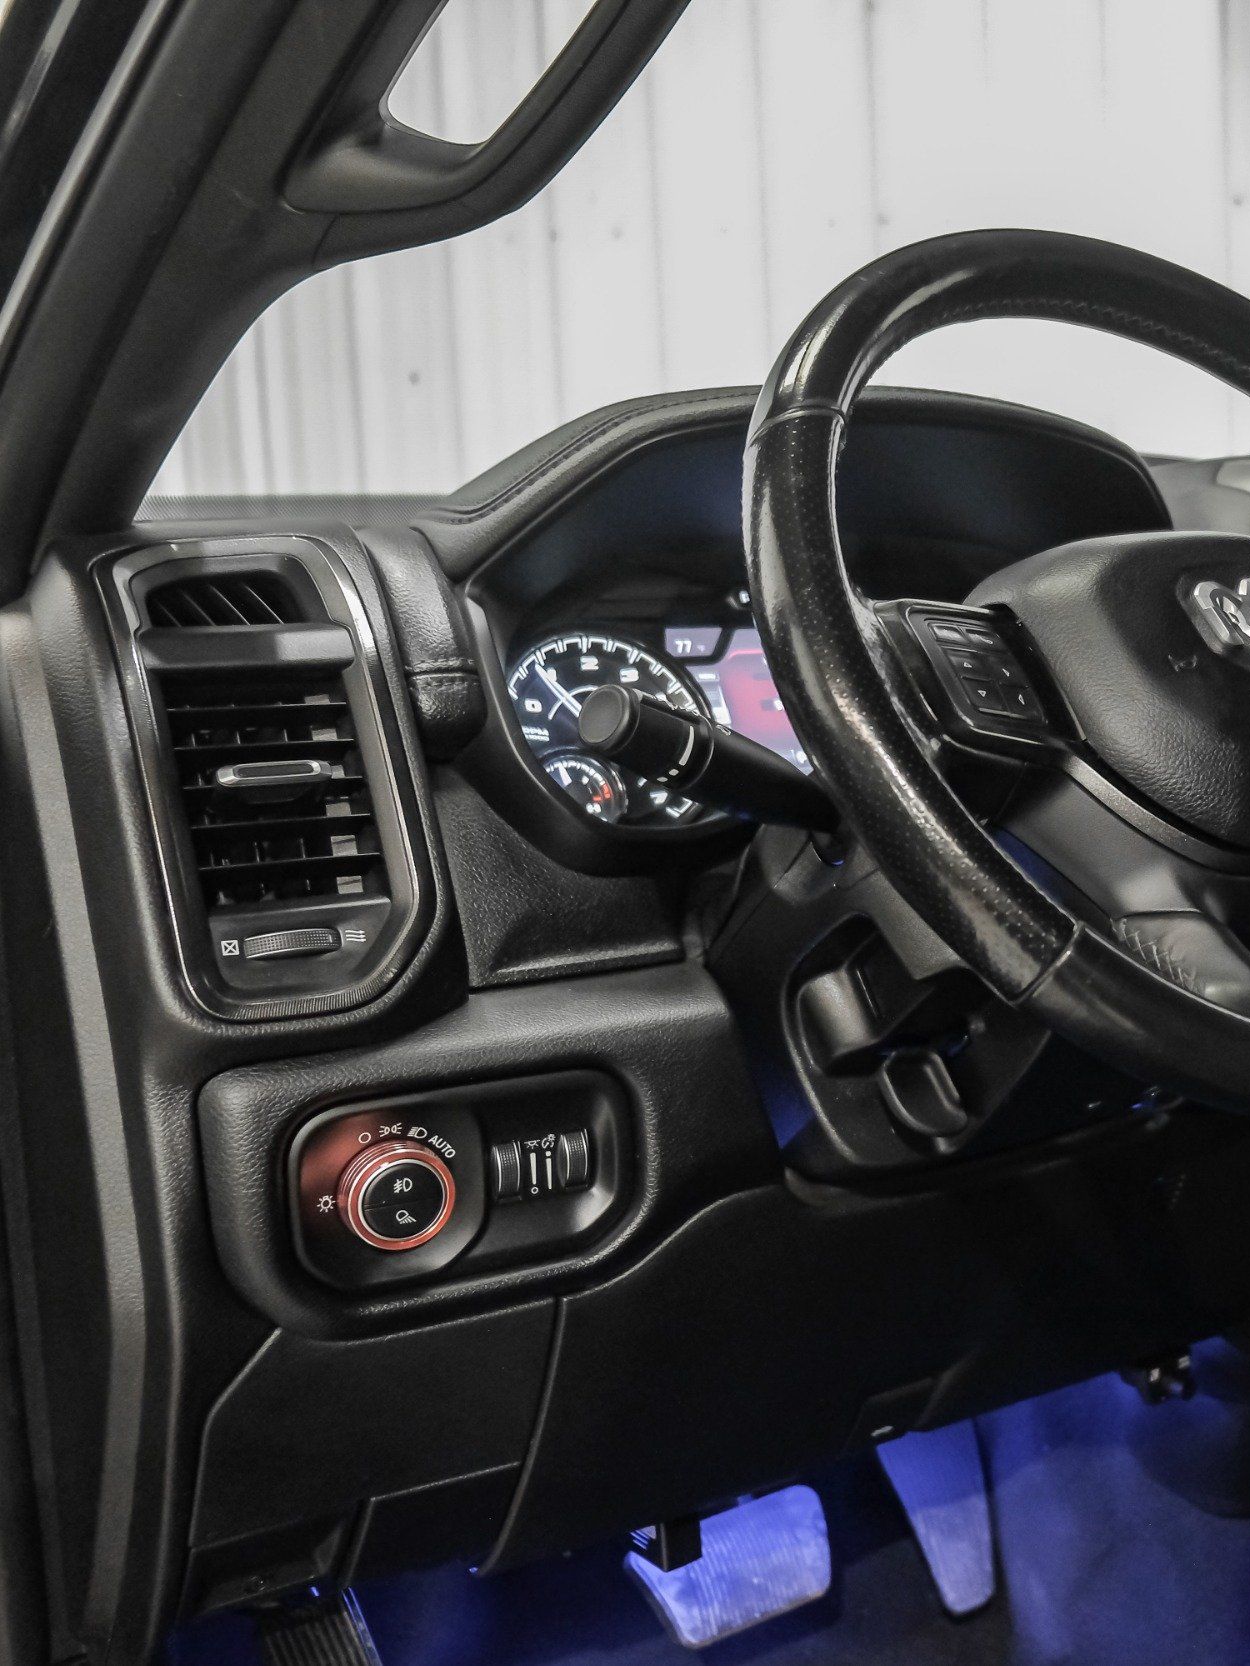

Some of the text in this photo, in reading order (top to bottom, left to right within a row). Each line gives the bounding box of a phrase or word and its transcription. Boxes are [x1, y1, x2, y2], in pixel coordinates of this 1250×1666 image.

[580, 656, 599, 671] 2
[524, 698, 543, 713] 0
[428, 1135, 456, 1158] AUTO
